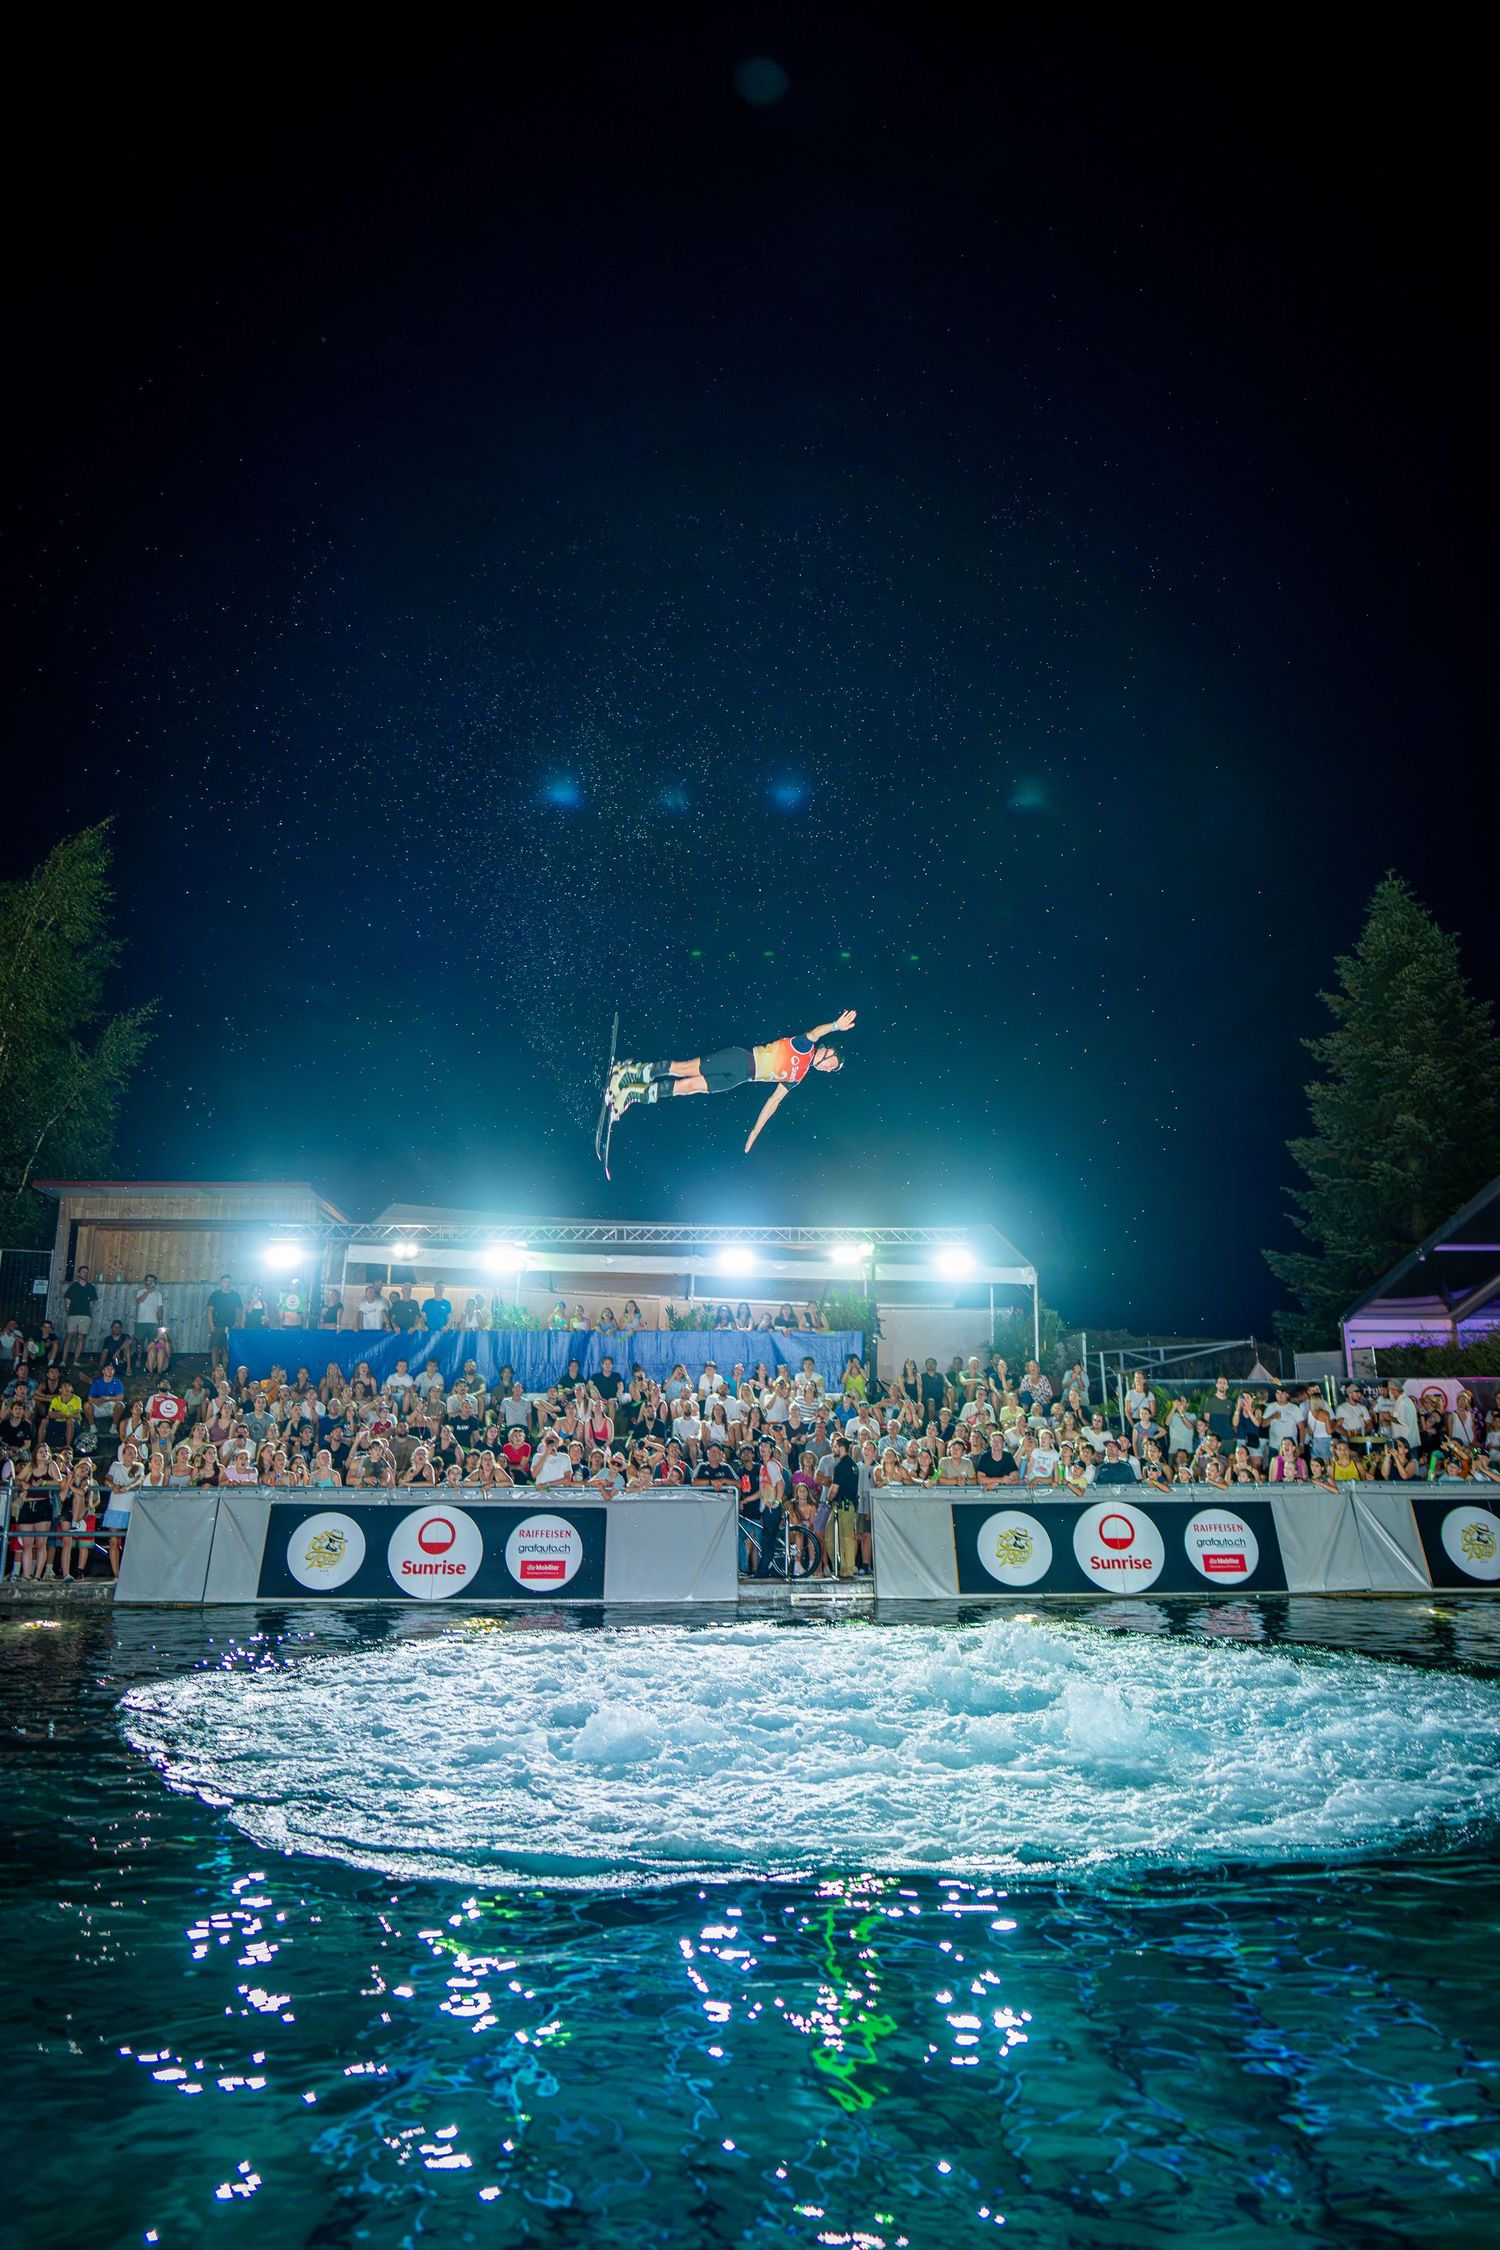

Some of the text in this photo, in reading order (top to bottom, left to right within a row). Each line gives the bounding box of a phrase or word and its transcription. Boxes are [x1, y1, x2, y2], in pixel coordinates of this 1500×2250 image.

[519, 1529, 572, 1538] RAIFFEISEN
[1193, 1523, 1244, 1533] RAIFFEISEN
[518, 1543, 571, 1554] grafauto.ch
[401, 1559, 467, 1575] Sunrise
[1090, 1554, 1153, 1570] Sunrise
